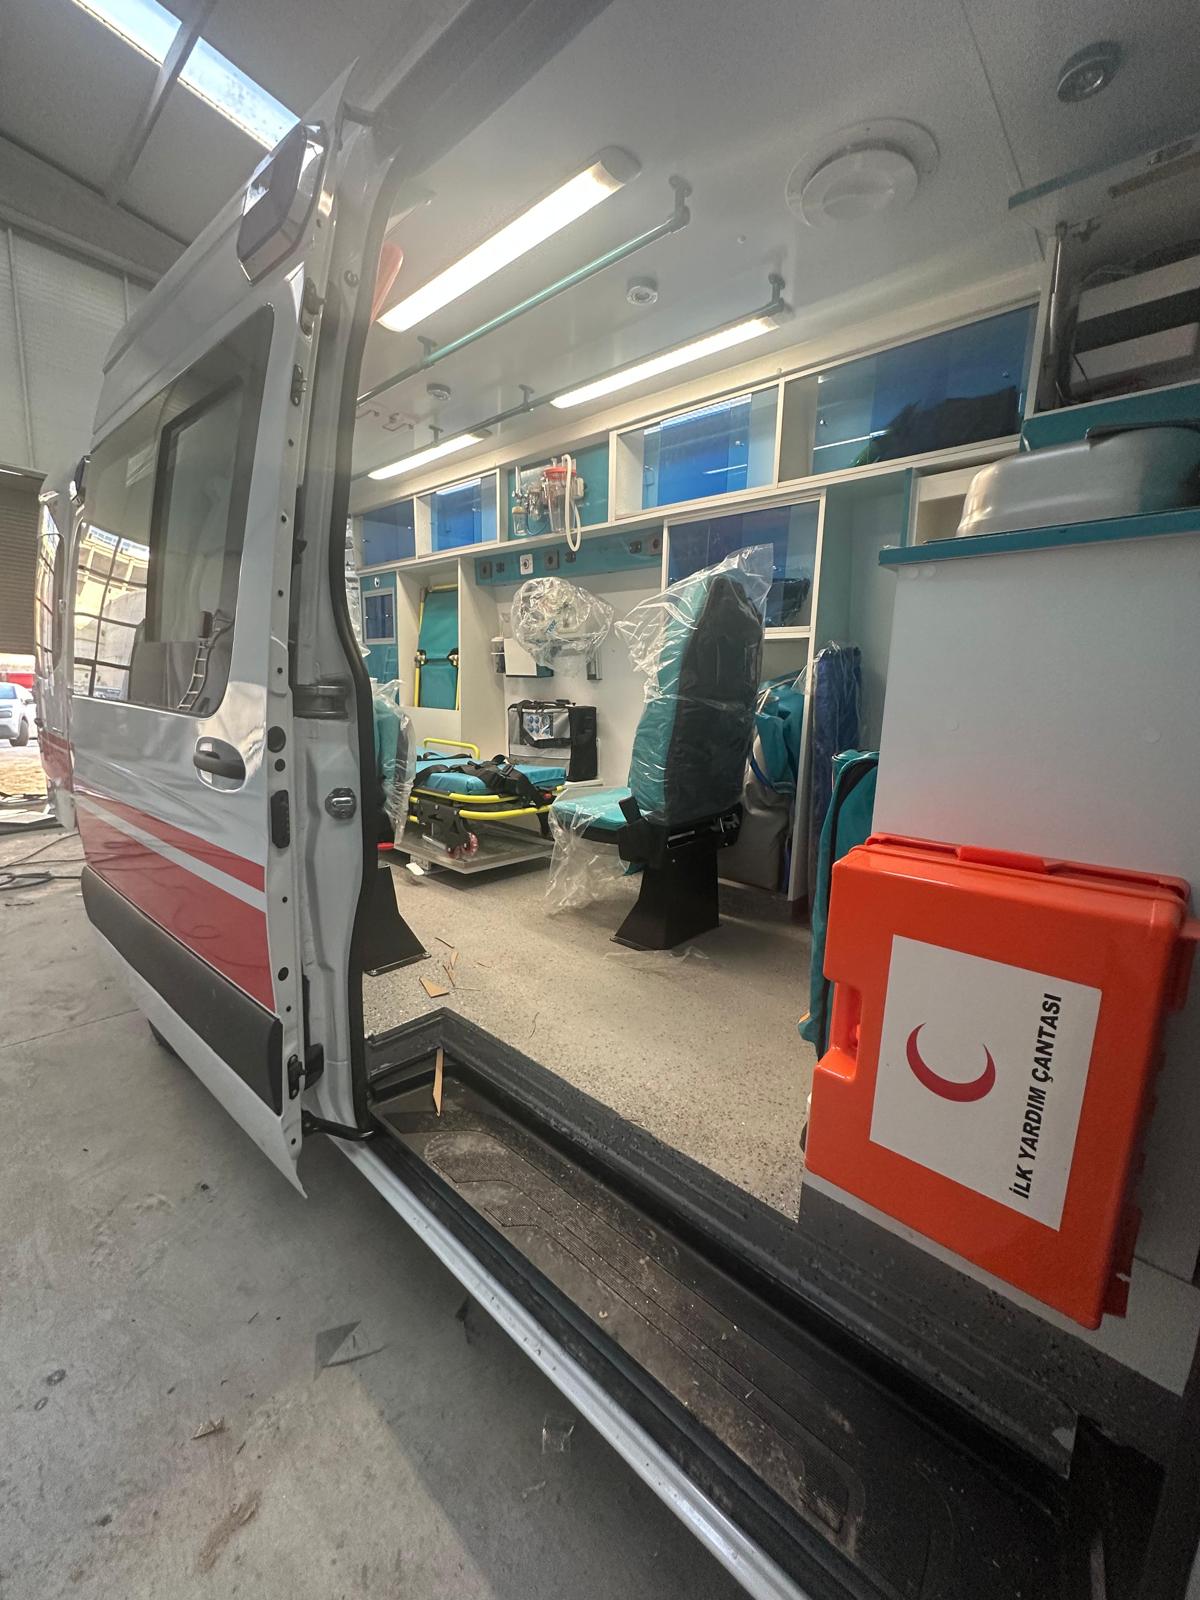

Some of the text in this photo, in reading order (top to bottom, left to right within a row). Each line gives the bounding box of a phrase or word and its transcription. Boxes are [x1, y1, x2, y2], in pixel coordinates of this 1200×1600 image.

[1008, 992, 1062, 1200] İLK YARDIM ÇANTASI
